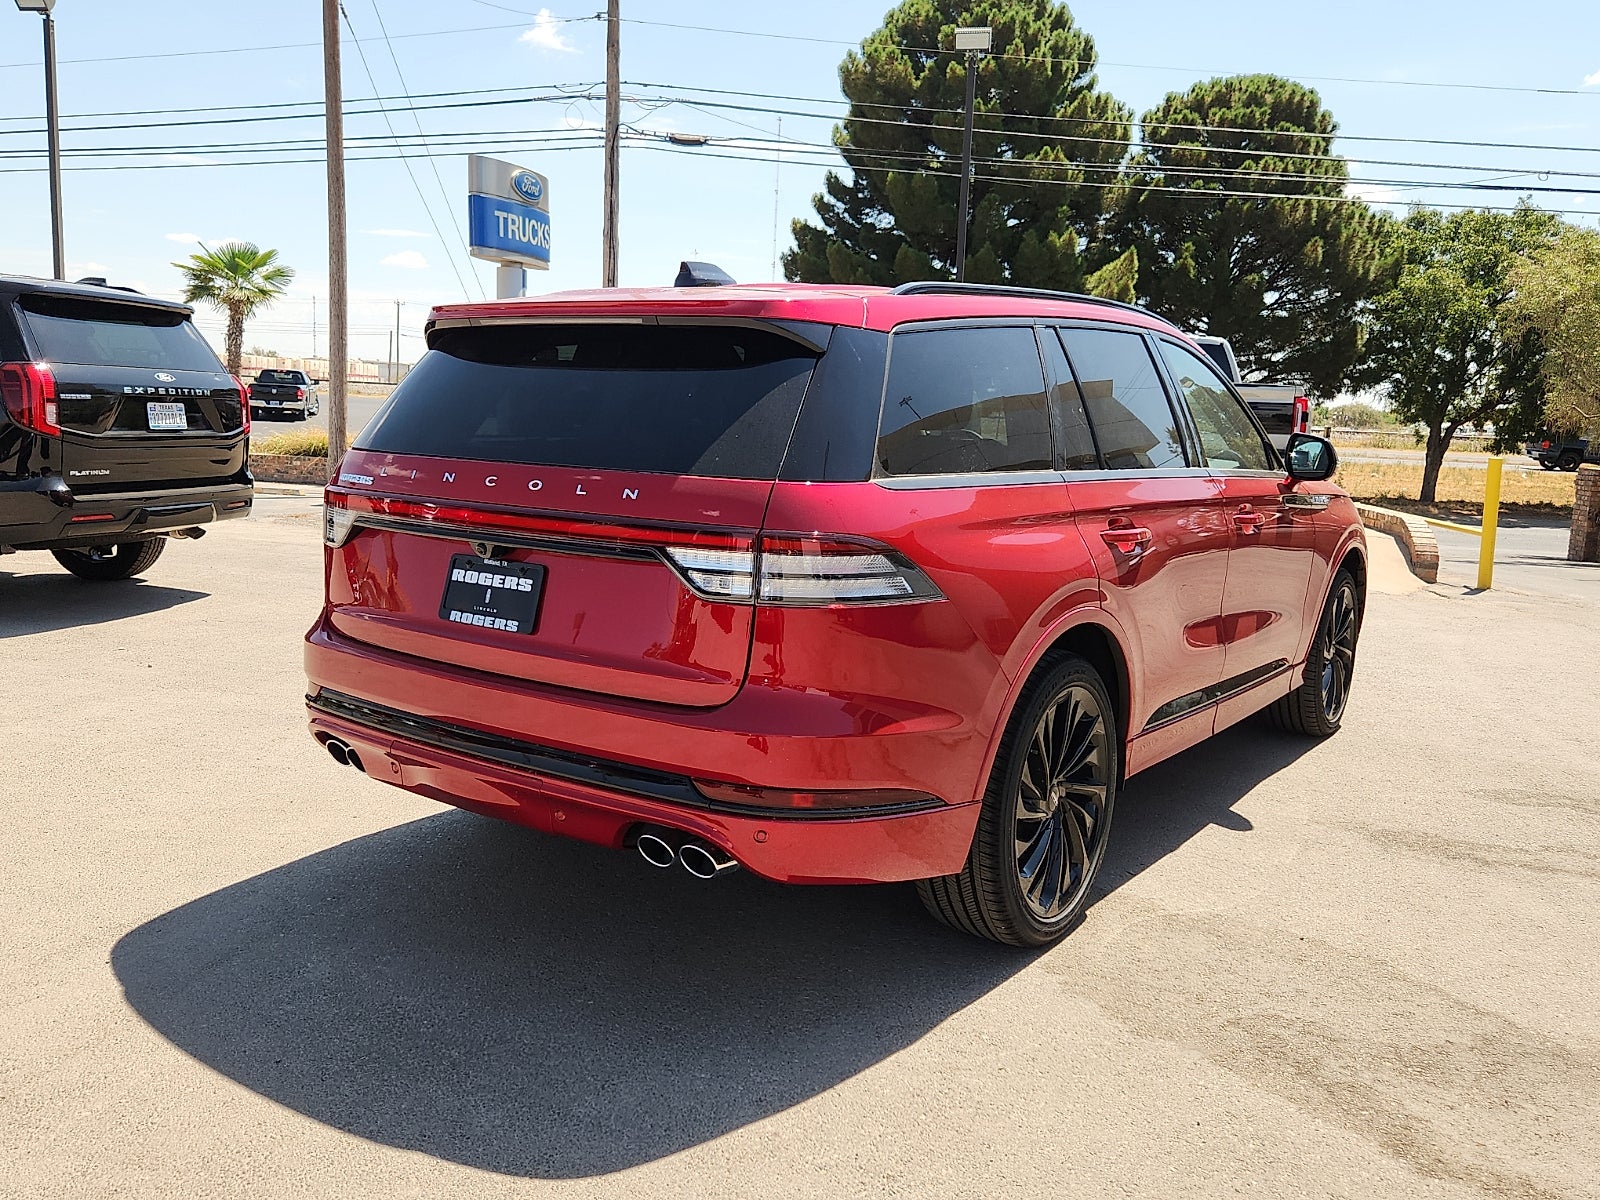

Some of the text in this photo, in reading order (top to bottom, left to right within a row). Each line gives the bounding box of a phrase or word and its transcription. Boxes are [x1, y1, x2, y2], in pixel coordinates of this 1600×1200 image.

[521, 175, 540, 196] Ford
[494, 210, 550, 249] TRUCKS
[123, 386, 211, 397] EXPEDITION
[380, 467, 639, 500] LINCOLN
[451, 568, 533, 592] ROGERS
[449, 610, 519, 632] ROGERS
